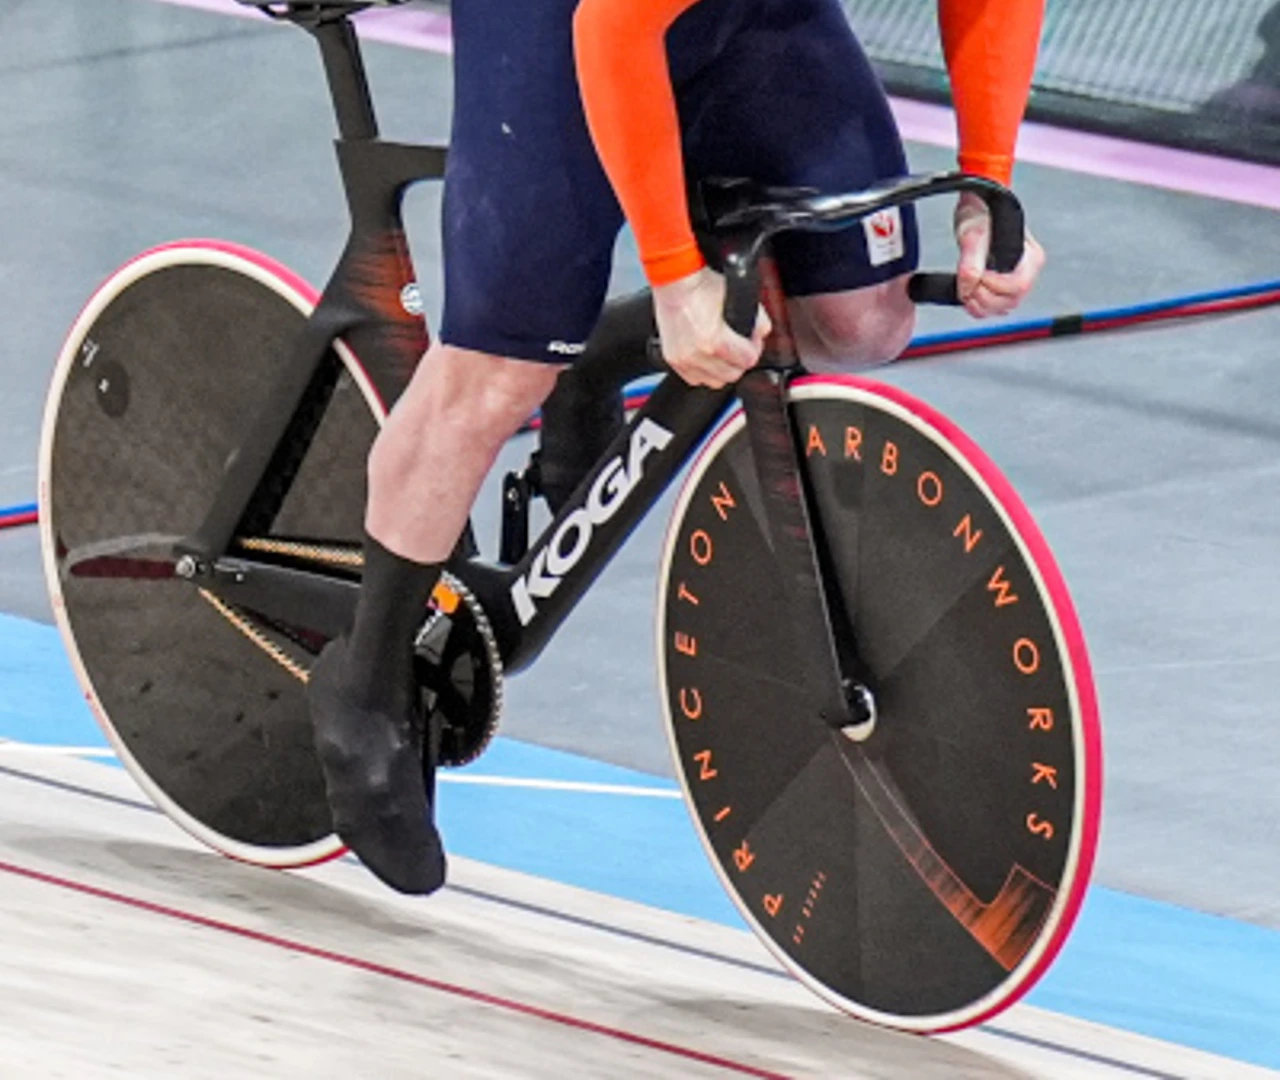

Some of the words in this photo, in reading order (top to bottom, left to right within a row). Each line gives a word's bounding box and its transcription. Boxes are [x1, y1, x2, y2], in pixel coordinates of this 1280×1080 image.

[510, 417, 675, 627] KOGA
[675, 482, 784, 918] PRINCETON
[806, 425, 1059, 840] ARBONWORKS
